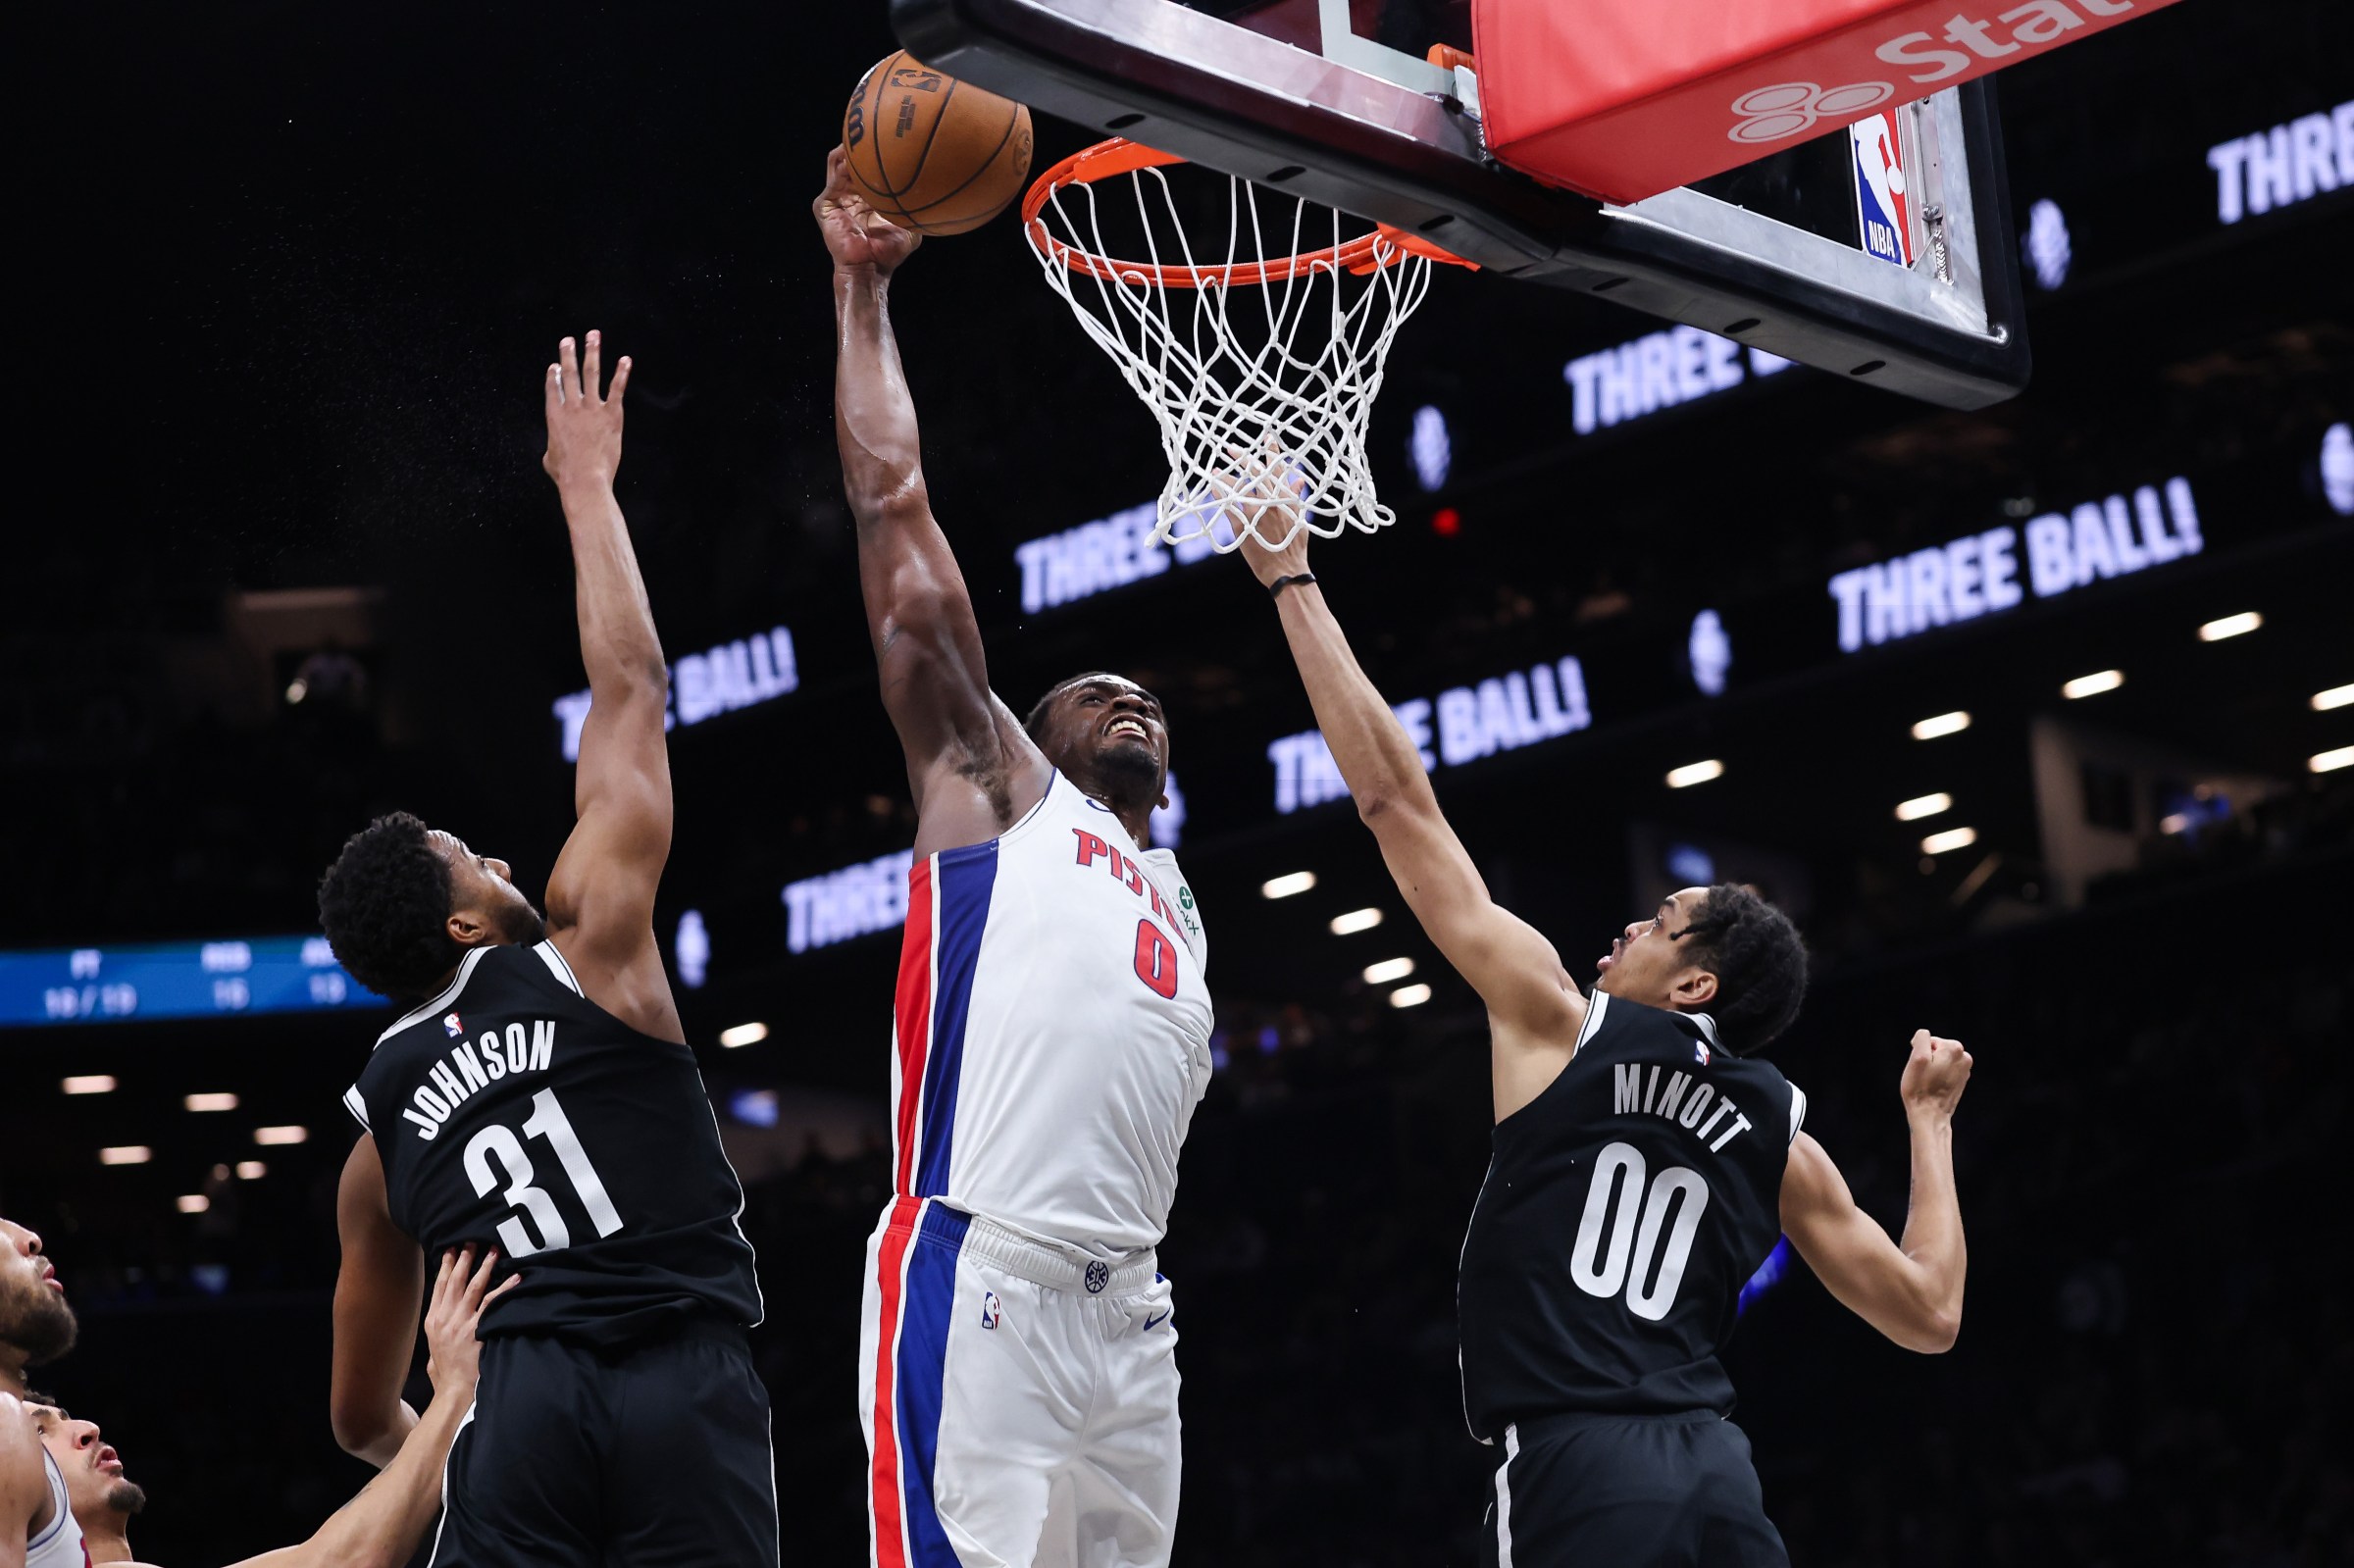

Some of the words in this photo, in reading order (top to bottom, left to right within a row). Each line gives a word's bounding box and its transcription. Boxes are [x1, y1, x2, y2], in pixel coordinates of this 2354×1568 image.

[1868, 219, 1895, 259] NBA
[1827, 526, 2023, 654] THREE
[2024, 476, 2205, 598] BALL!
[1436, 654, 1593, 768] BALL!
[1134, 918, 1177, 1000] 0
[402, 1020, 555, 1140] JOHNSON
[1614, 1063, 1752, 1153] MINOTT
[463, 1087, 624, 1258] 31
[1570, 1141, 1710, 1321] 00
